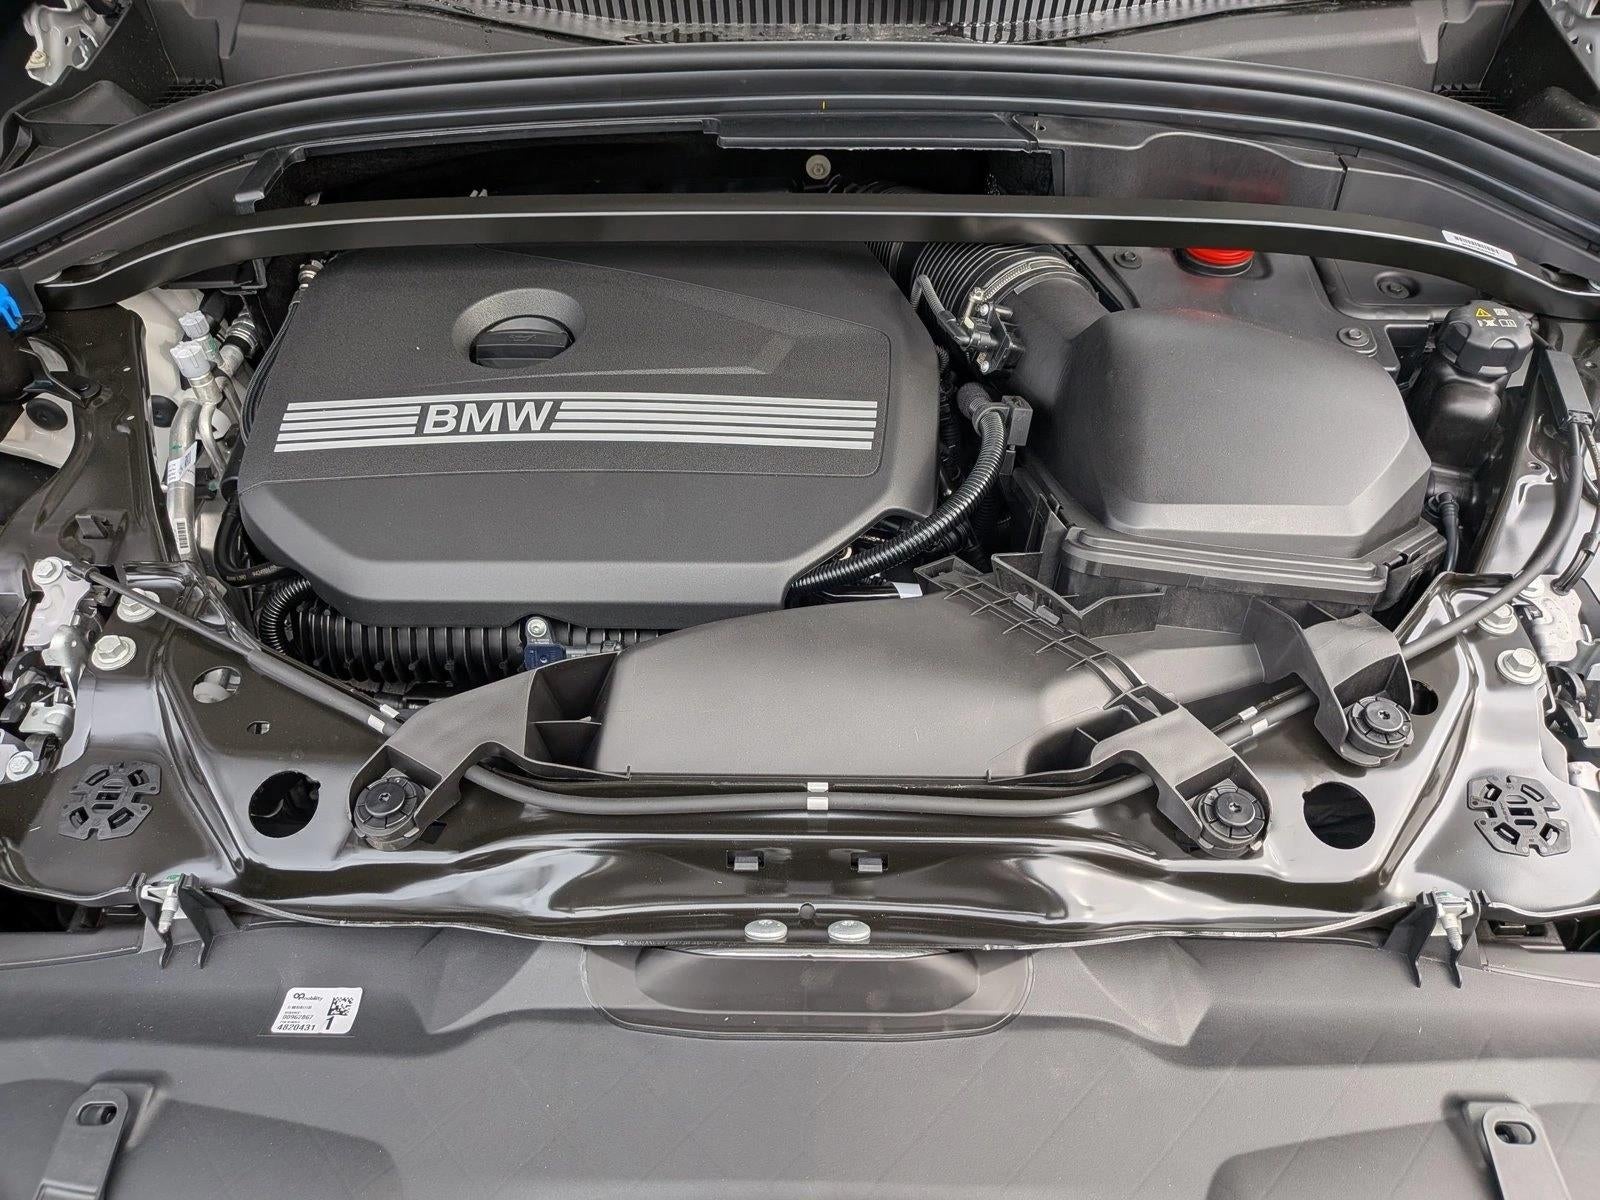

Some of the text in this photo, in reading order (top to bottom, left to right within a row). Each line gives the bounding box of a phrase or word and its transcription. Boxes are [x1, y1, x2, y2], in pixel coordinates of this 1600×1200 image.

[423, 401, 554, 434] BMW
[277, 1023, 316, 1031] 4820431
[325, 1016, 335, 1030] 1
